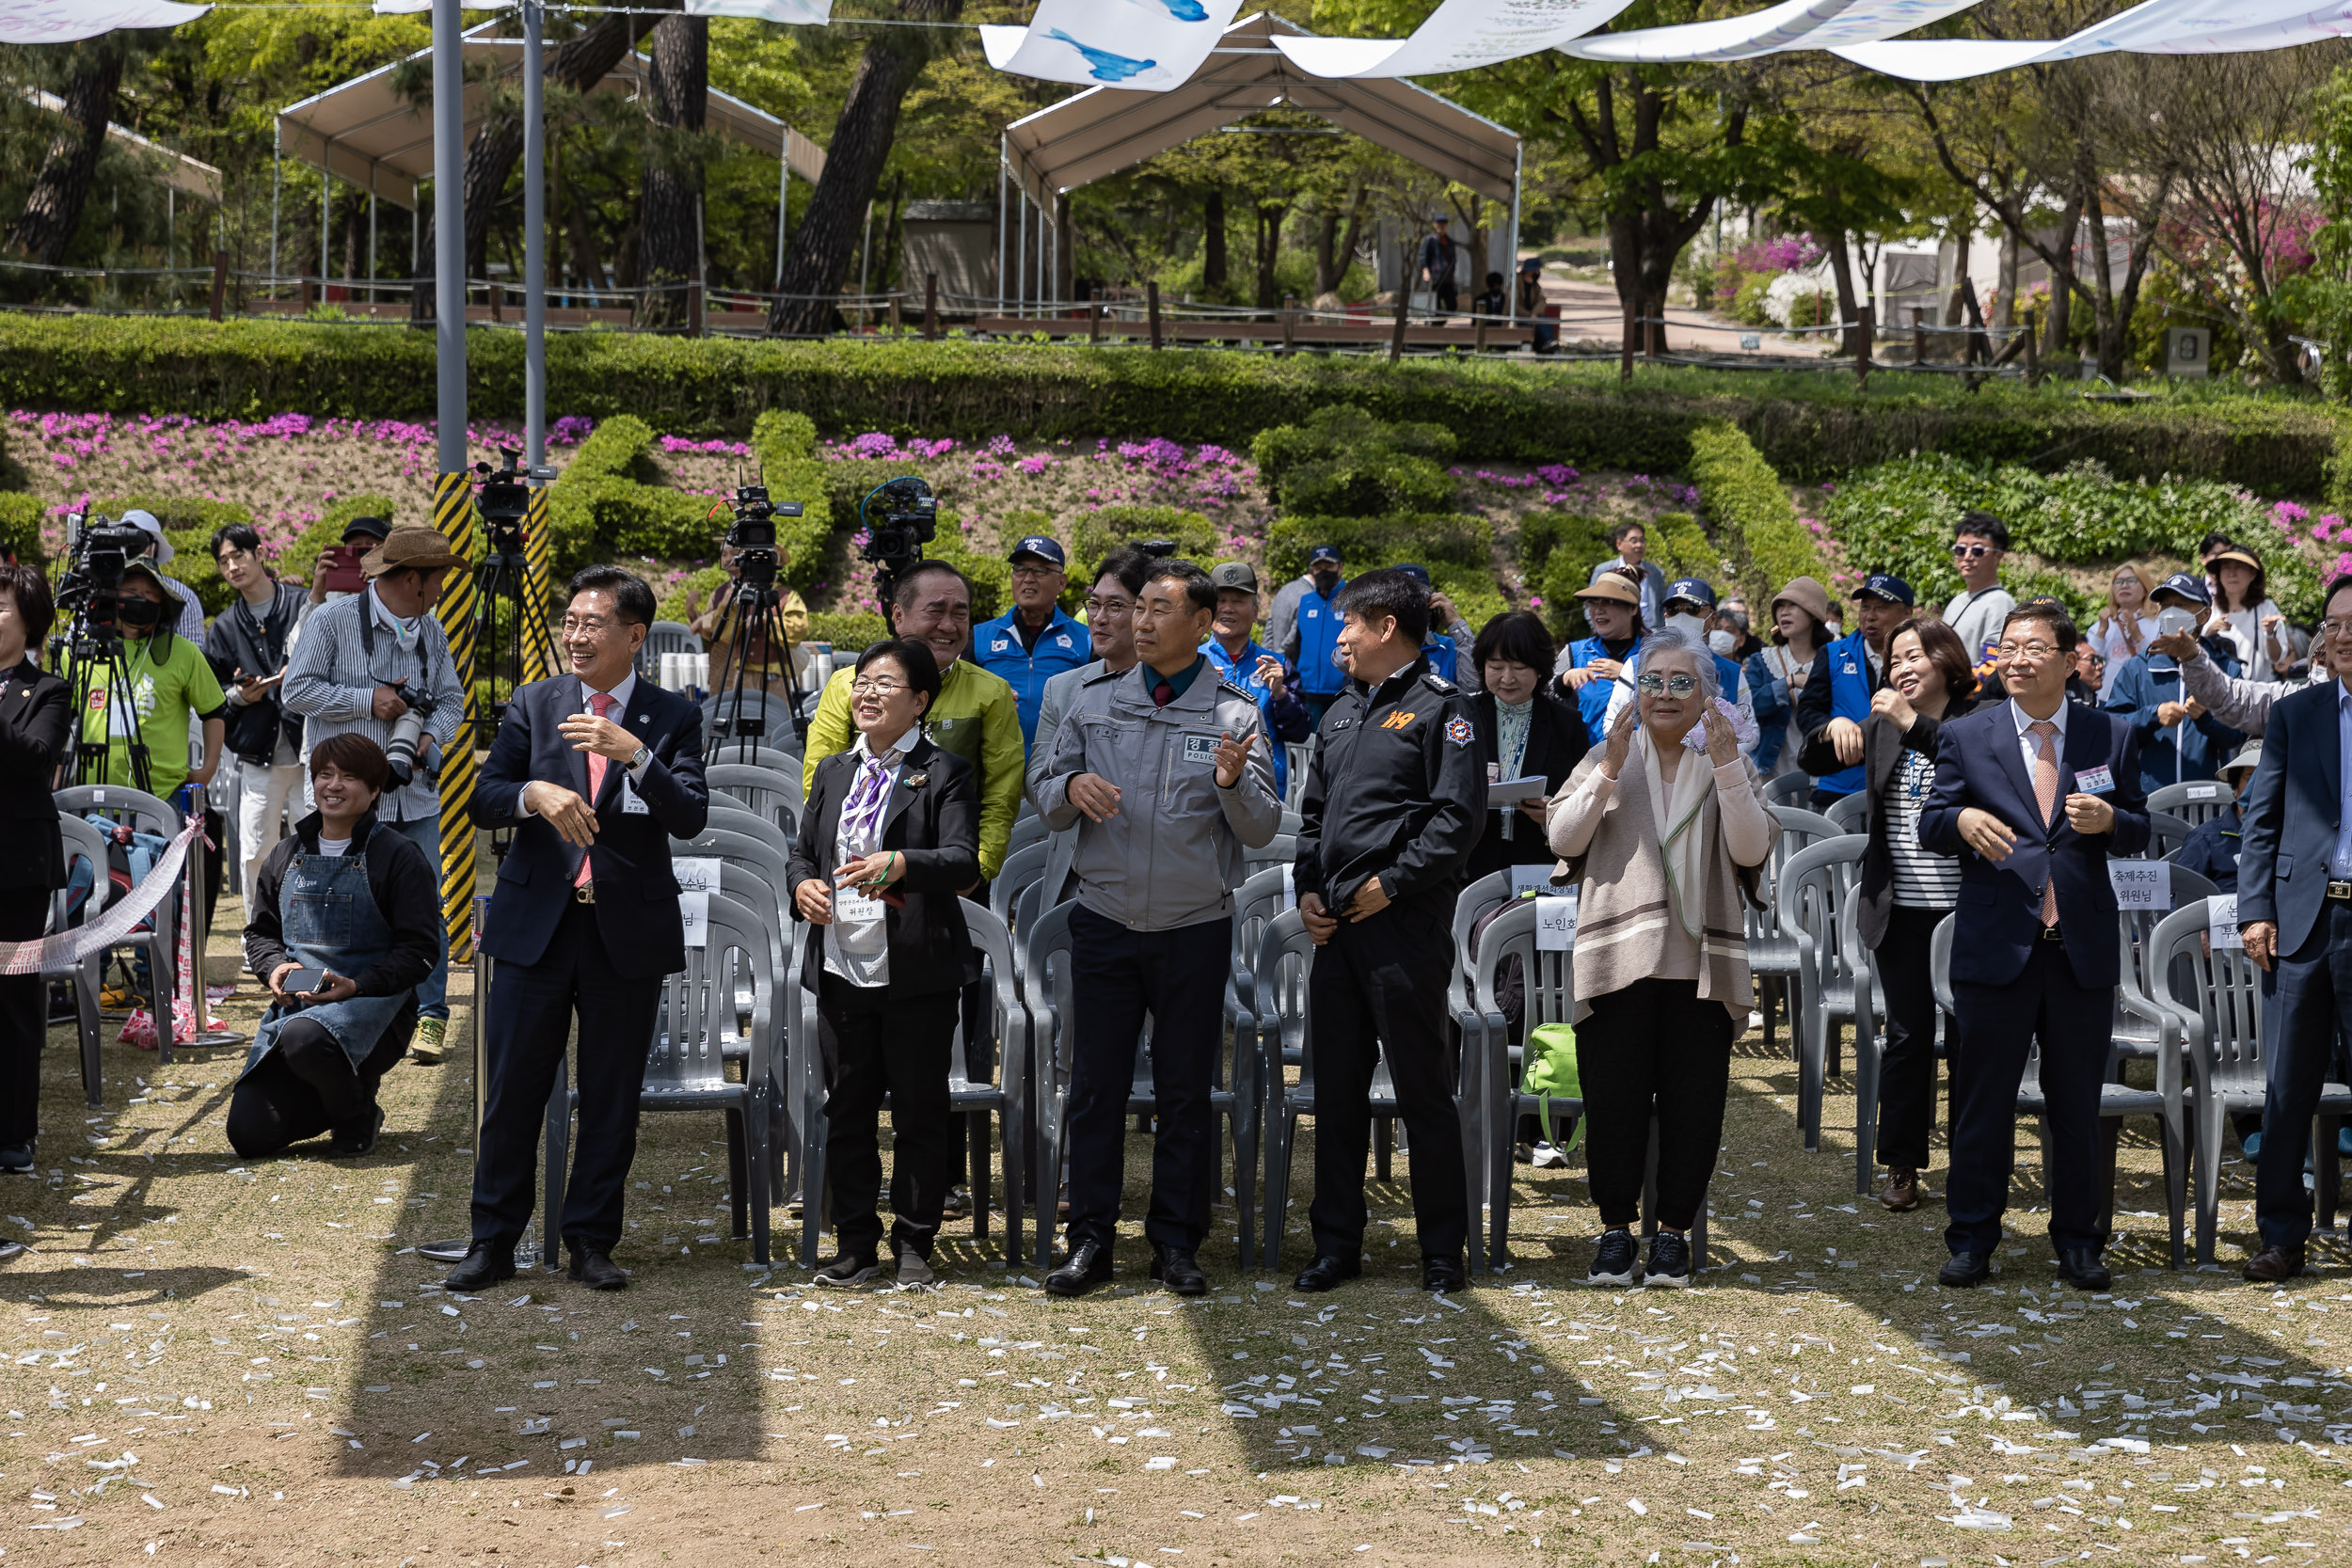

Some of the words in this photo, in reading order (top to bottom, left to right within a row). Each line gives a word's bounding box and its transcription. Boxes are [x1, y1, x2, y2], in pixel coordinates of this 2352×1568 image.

[1380, 711, 1416, 730] 119
[1189, 738, 1220, 753] 경찰
[2113, 869, 2157, 882] 축제추진
[2119, 889, 2152, 903] 위원님
[849, 906, 874, 916] 위원장
